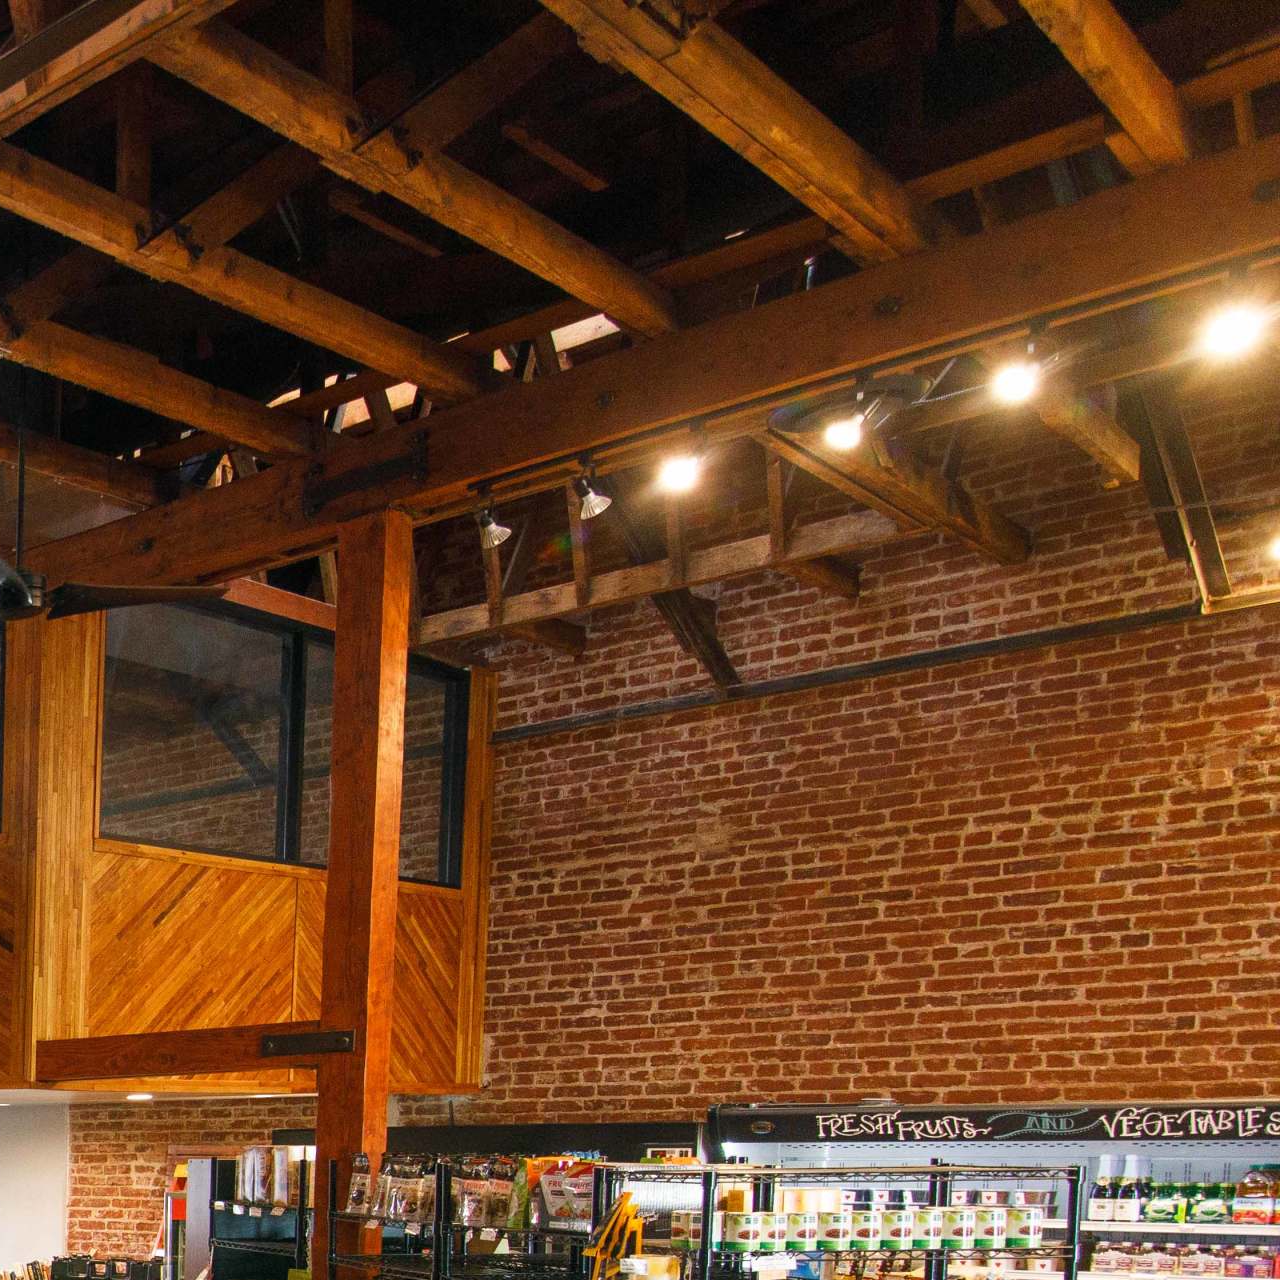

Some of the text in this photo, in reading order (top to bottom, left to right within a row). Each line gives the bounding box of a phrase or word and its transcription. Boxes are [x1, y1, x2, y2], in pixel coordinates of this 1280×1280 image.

[816, 1107, 1280, 1141] FRESH FRUITS AND VEGETABLES
